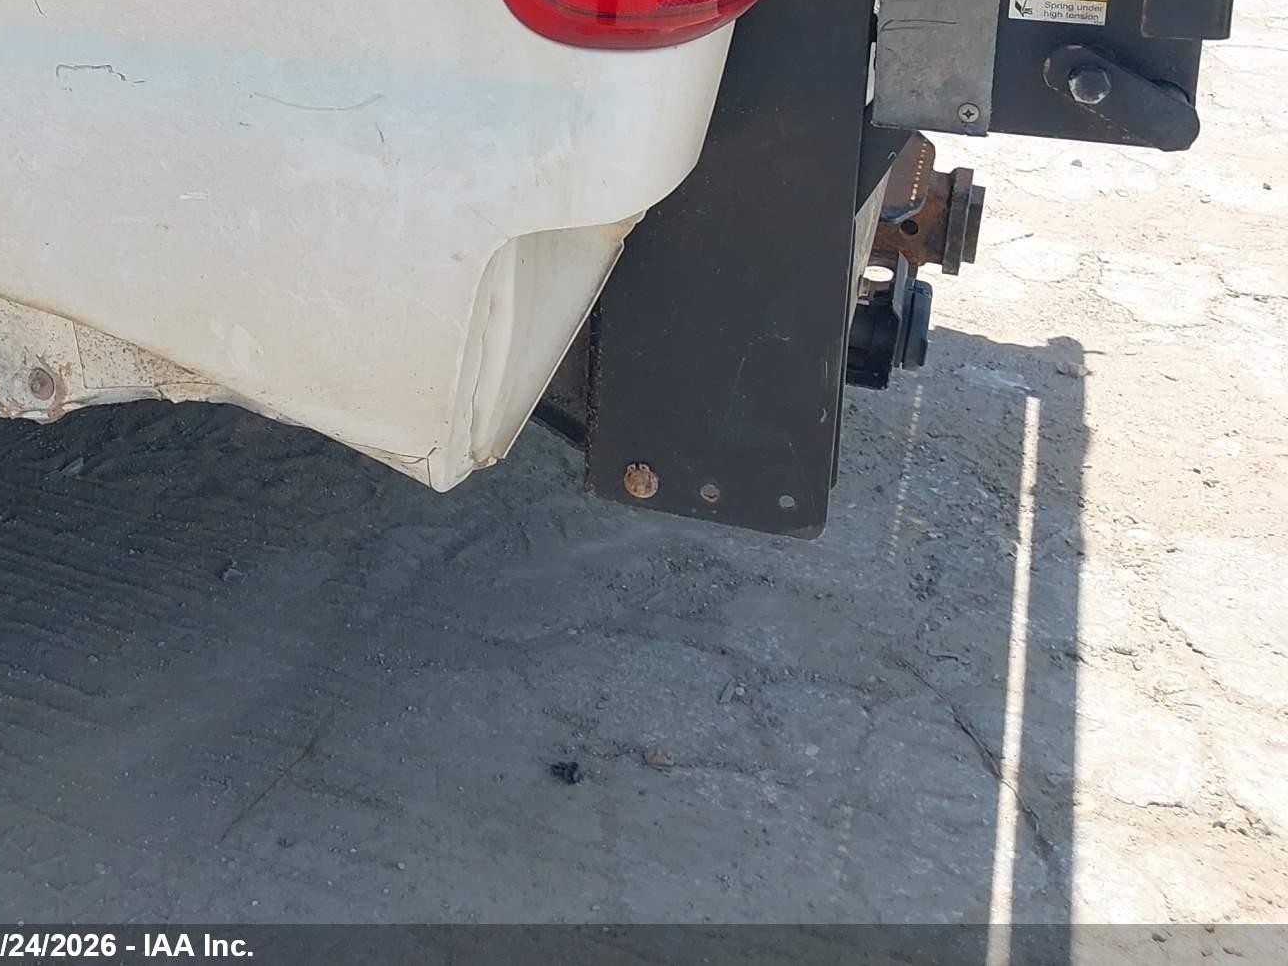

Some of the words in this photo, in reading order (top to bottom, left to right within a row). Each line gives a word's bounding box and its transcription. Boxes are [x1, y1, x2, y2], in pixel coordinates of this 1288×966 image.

[1044, 0, 1074, 12] Spring
[1076, 4, 1103, 12] under
[1043, 10, 1063, 19] high
[1066, 12, 1099, 21] tension
